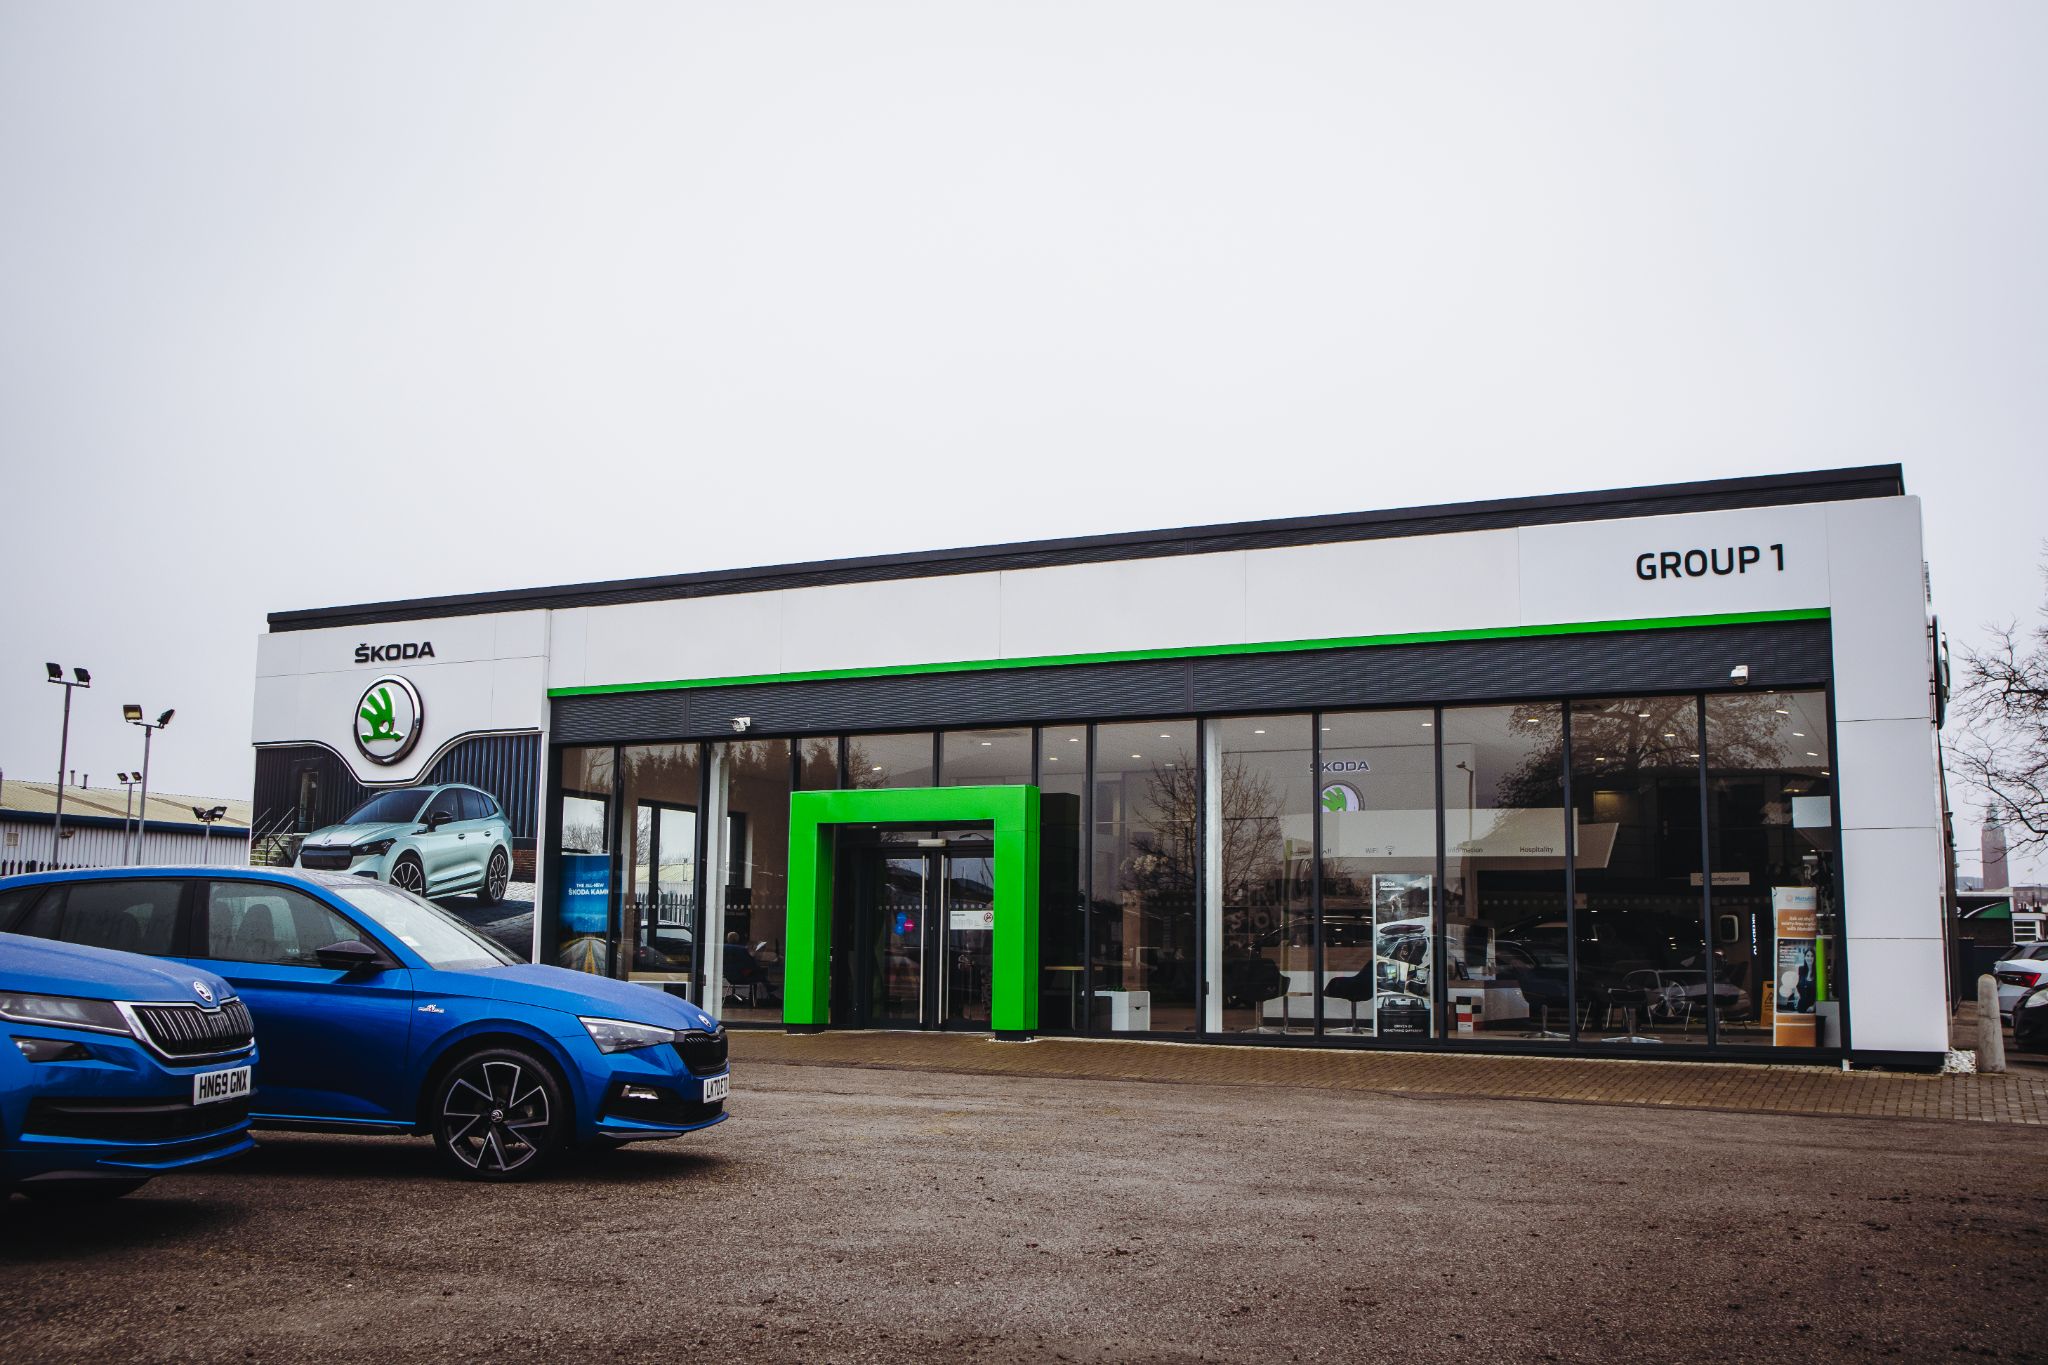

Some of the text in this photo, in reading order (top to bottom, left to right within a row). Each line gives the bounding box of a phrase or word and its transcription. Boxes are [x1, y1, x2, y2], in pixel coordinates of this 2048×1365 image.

[1636, 544, 1784, 580] GROUP 1
[354, 641, 435, 663] ŠKODA
[1519, 846, 1554, 854] Hospitality
[199, 1069, 248, 1099] HN69 GNX
